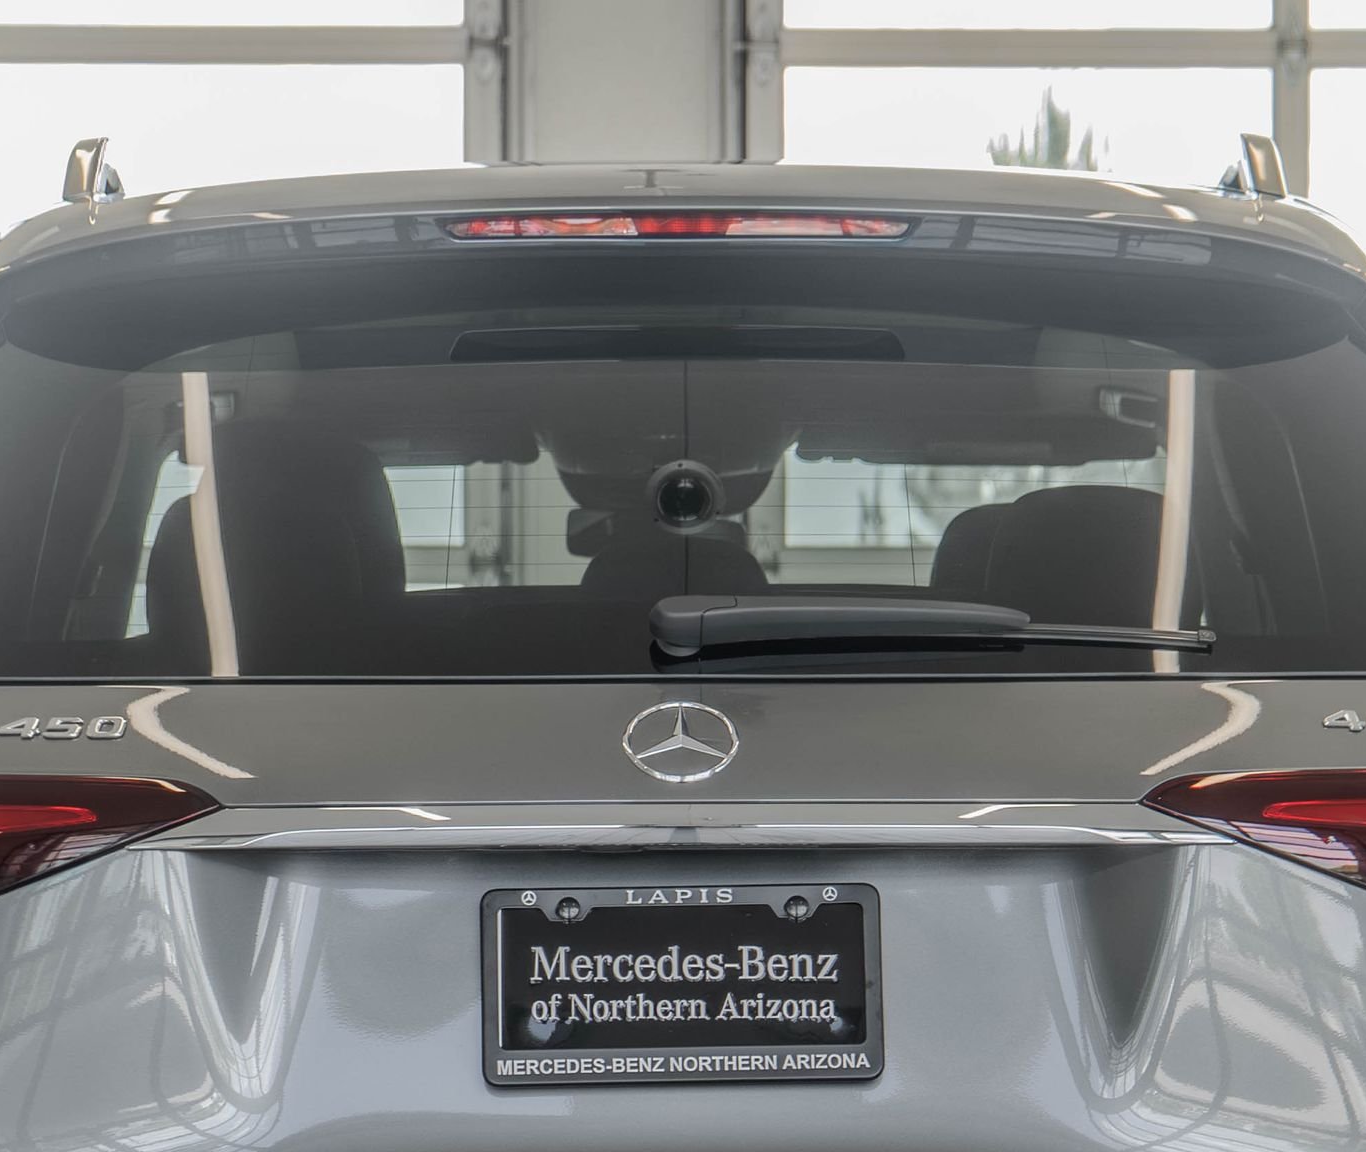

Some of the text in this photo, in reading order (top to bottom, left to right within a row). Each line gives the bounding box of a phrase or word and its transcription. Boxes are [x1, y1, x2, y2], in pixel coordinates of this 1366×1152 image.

[626, 889, 733, 904] LAPIS
[530, 946, 838, 983] Mercedes-Benz
[532, 993, 836, 1022] of Northern Arizona
[497, 1053, 871, 1076] MERCEDES-BENZ NORTHERN ARIZONA
